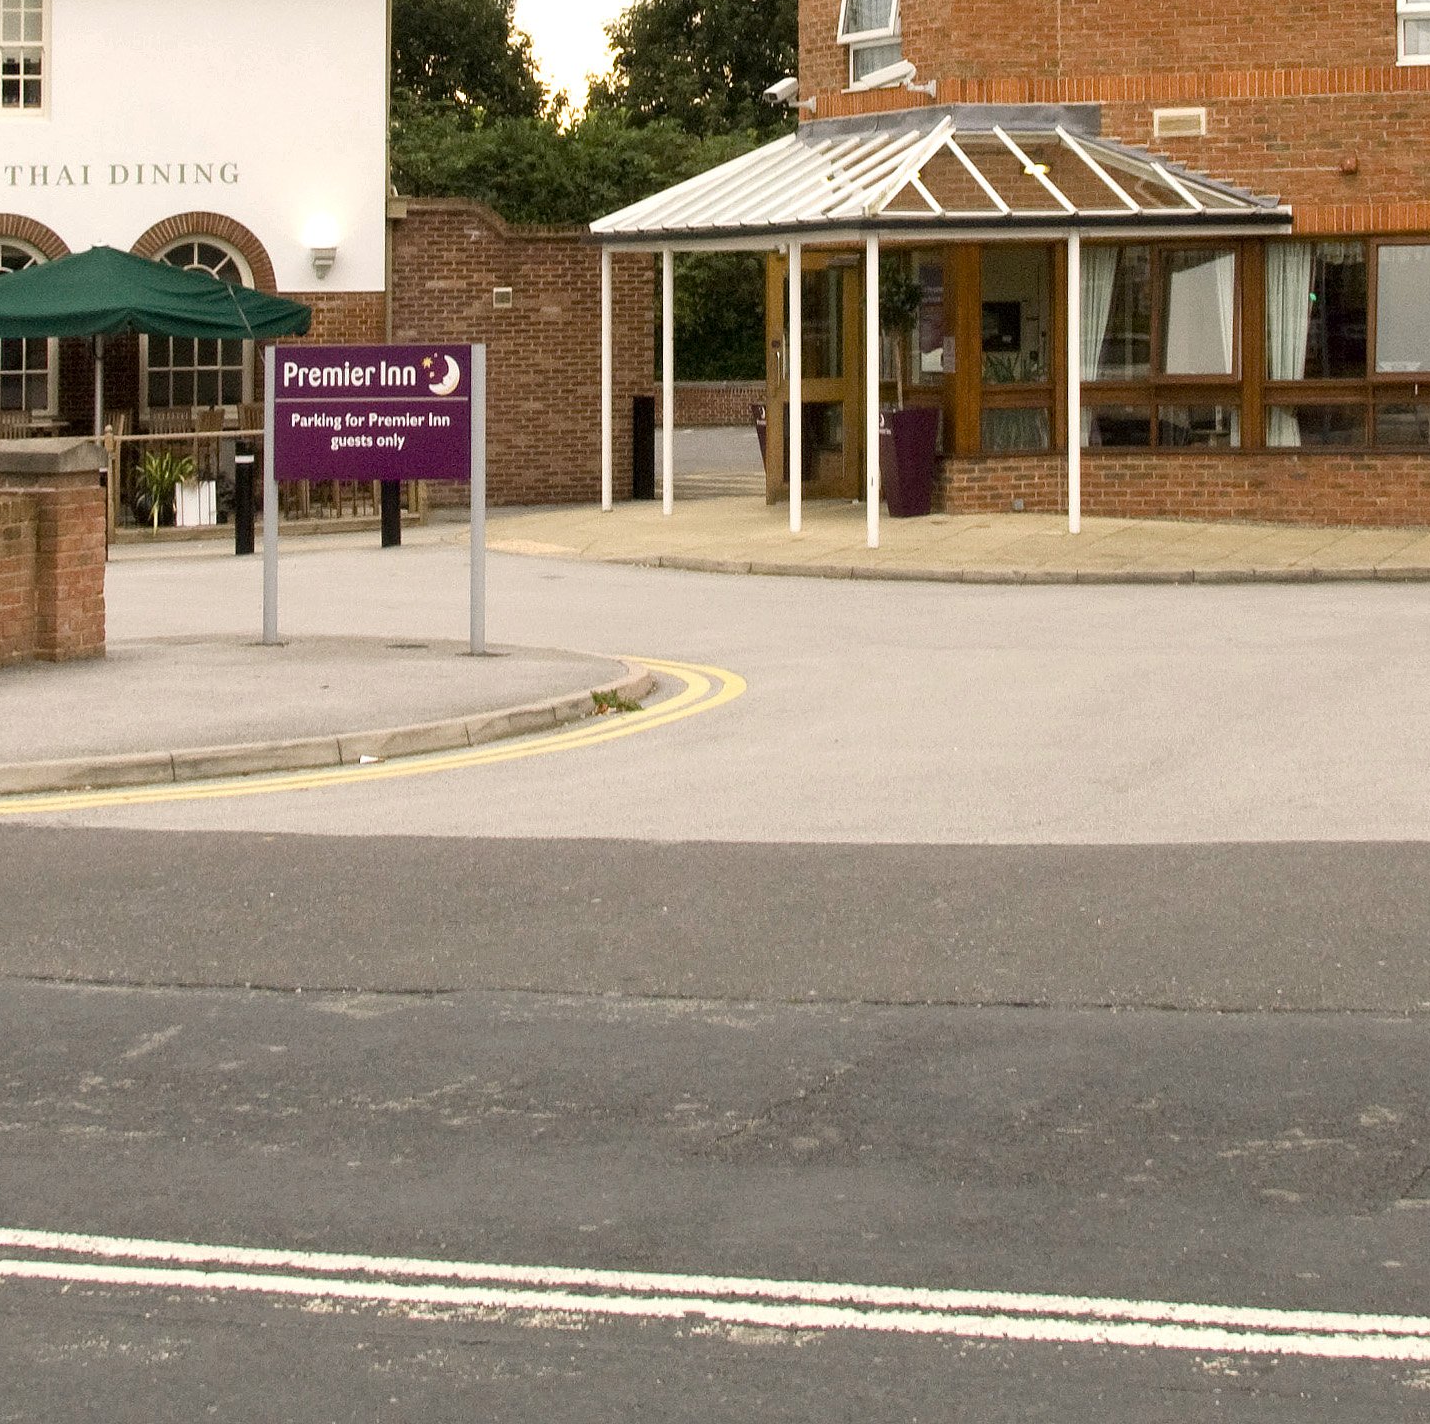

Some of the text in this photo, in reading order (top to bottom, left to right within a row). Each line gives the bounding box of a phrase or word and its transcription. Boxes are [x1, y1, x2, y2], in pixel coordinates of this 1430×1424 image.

[4, 162, 240, 186] THAI DINING
[283, 361, 416, 387] Premier Inn
[291, 412, 450, 430] Parking for Premier Inn
[330, 433, 405, 451] guests only
